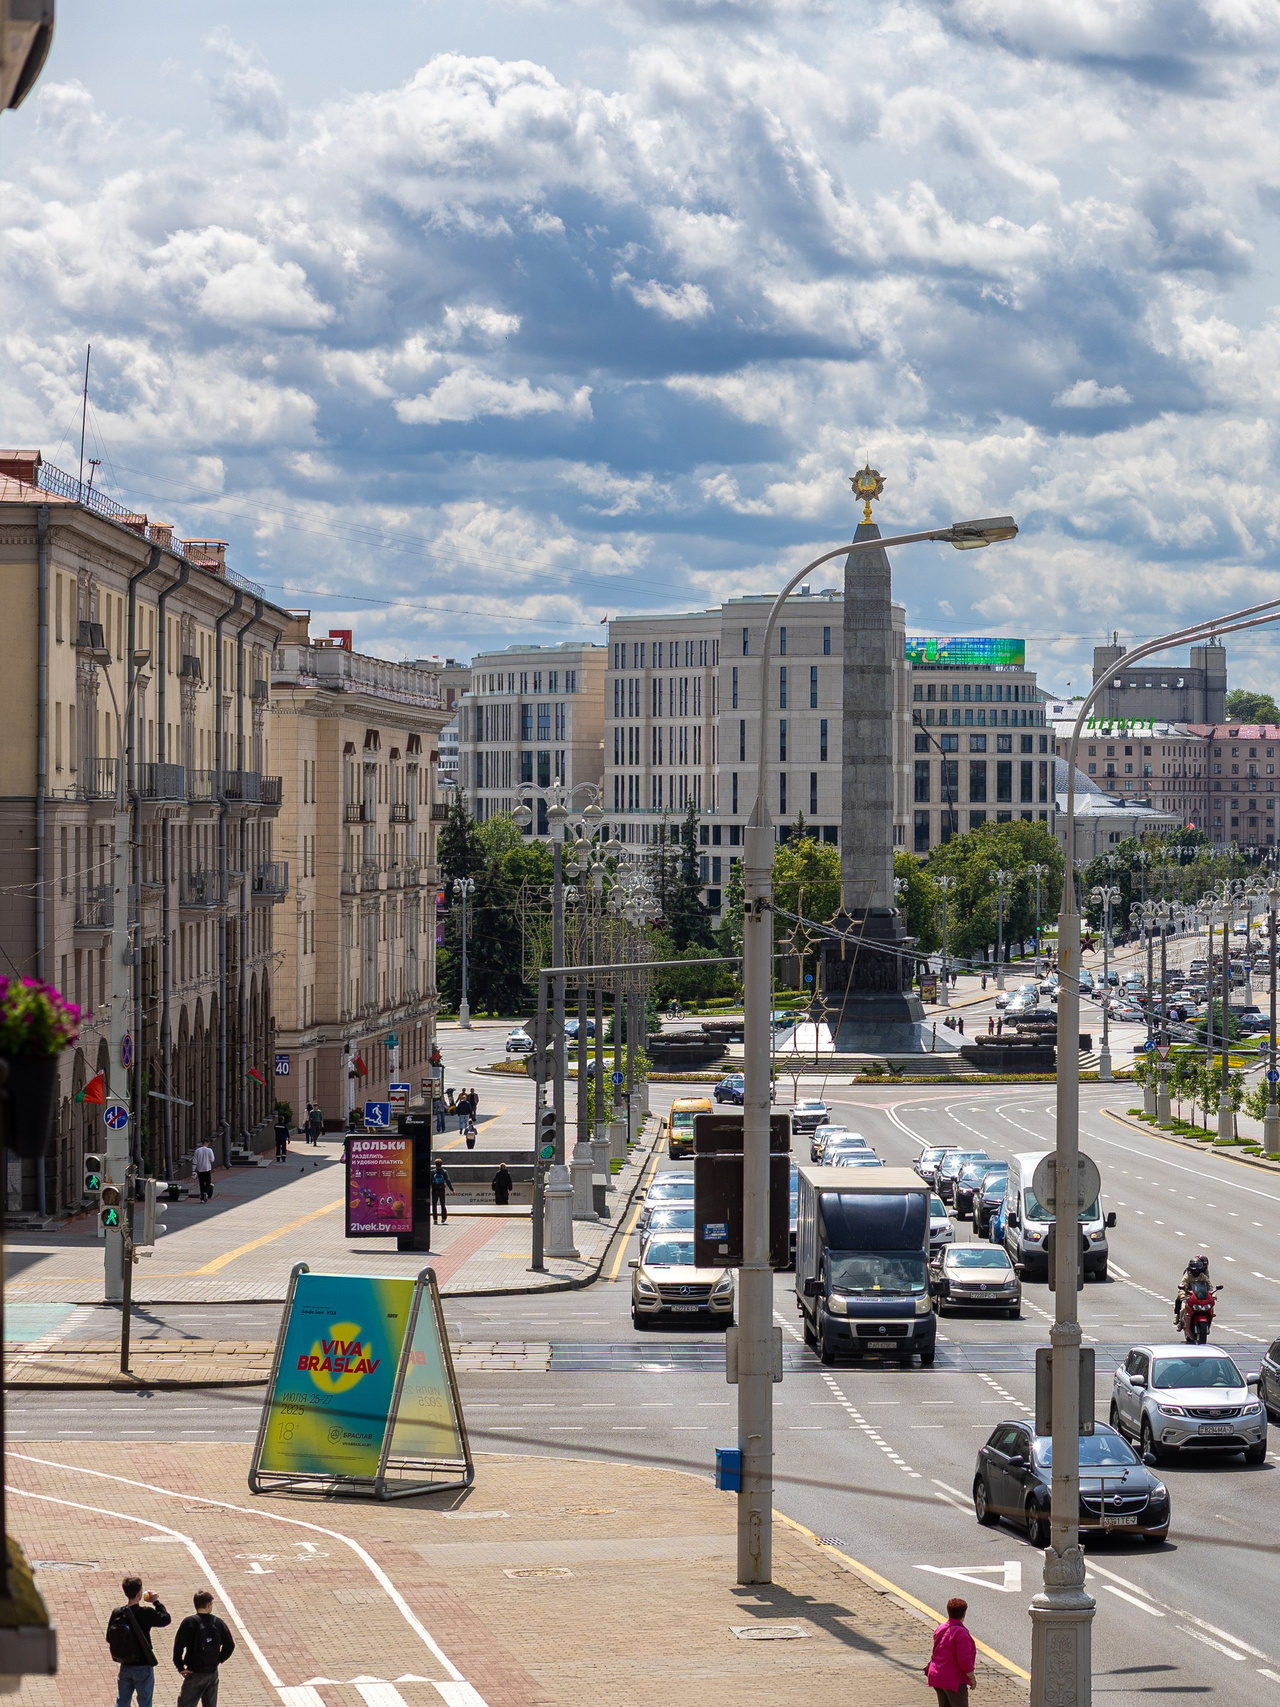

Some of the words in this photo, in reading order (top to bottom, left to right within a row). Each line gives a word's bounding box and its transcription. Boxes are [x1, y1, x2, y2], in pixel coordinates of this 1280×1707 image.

[275, 1062, 289, 1075] 40
[352, 1141, 406, 1151] ДОЛЬКИ
[350, 1222, 391, 1232] 21vek.by
[321, 1339, 363, 1357] VIVA
[296, 1354, 381, 1374] BRASLAV
[282, 1392, 308, 1403] ИЮЛЯ
[308, 1393, 334, 1405] 25-27
[280, 1403, 306, 1416] 2025
[342, 1432, 373, 1440] БРАСЛАВ
